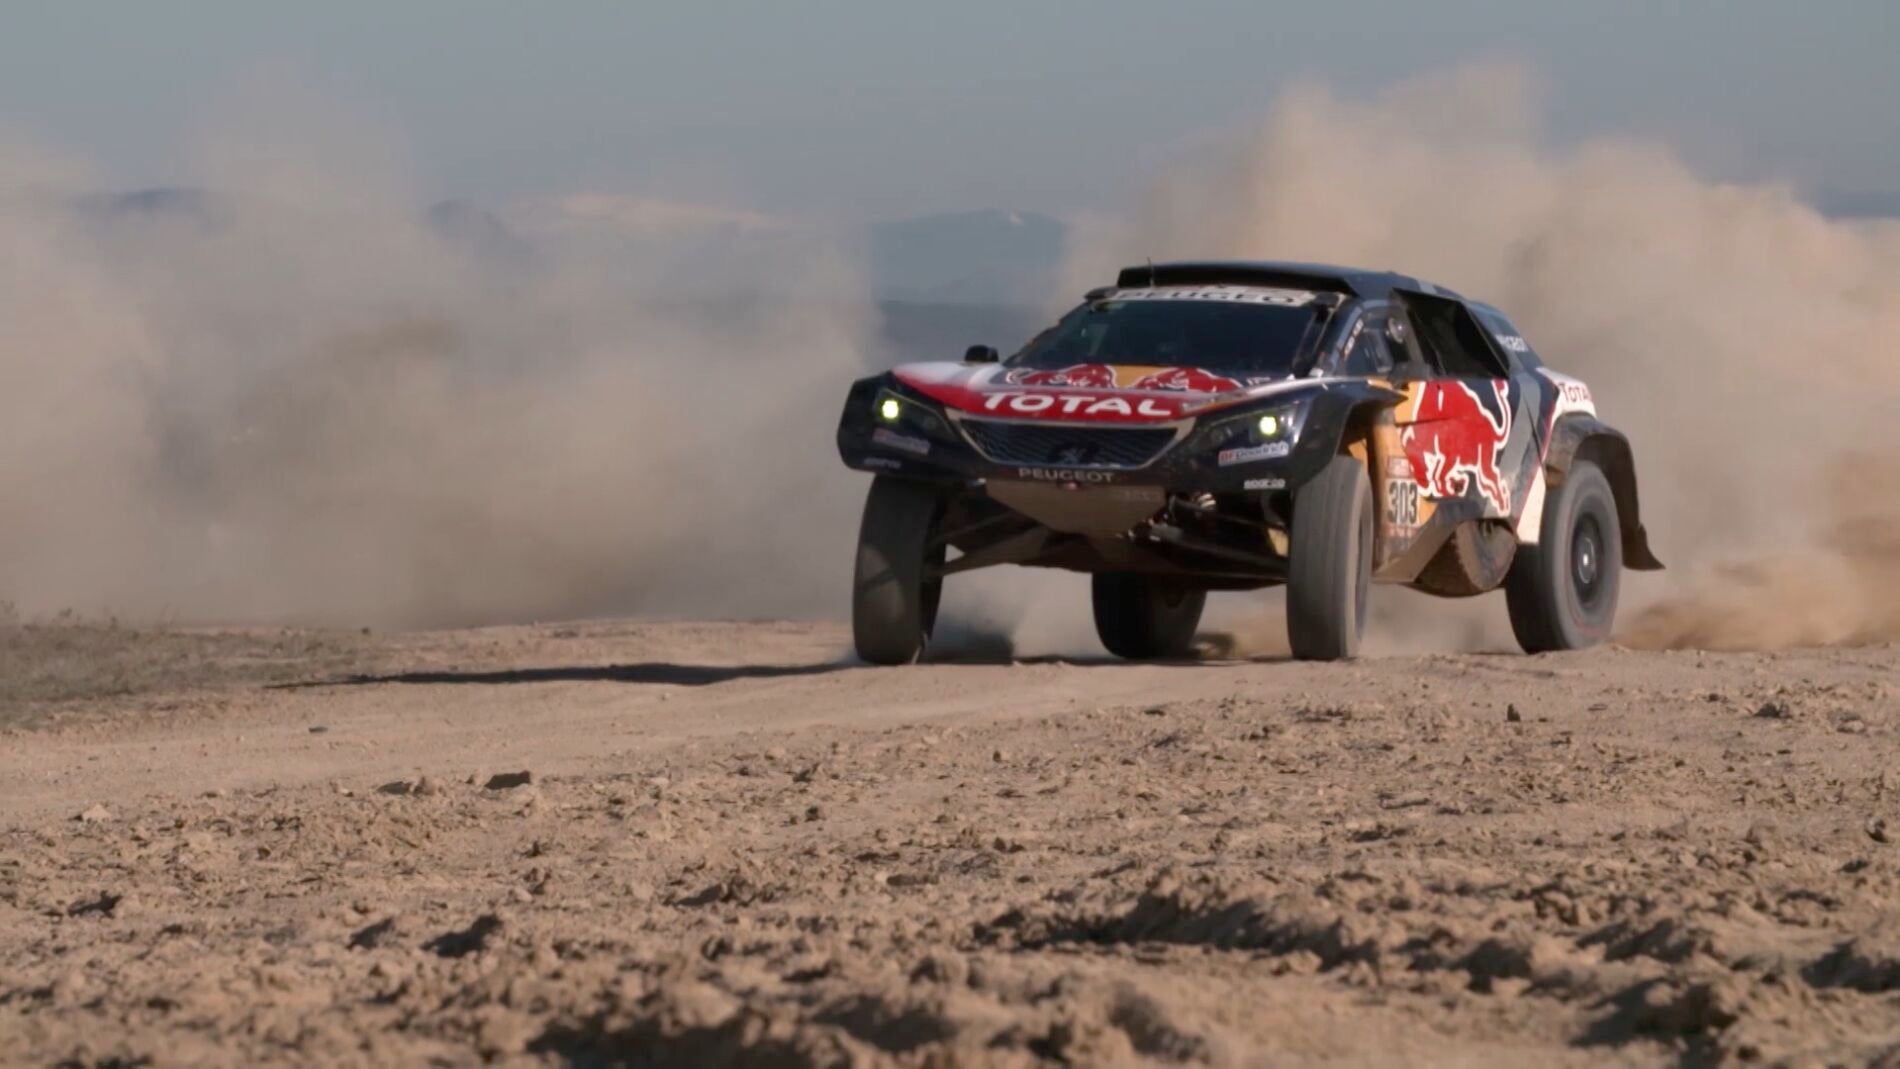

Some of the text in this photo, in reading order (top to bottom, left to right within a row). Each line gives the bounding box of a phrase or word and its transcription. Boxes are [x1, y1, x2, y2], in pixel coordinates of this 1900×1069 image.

[982, 391, 1172, 416] TOTAL
[1018, 467, 1114, 483] PEUGEOT
[1387, 481, 1420, 526] 303
